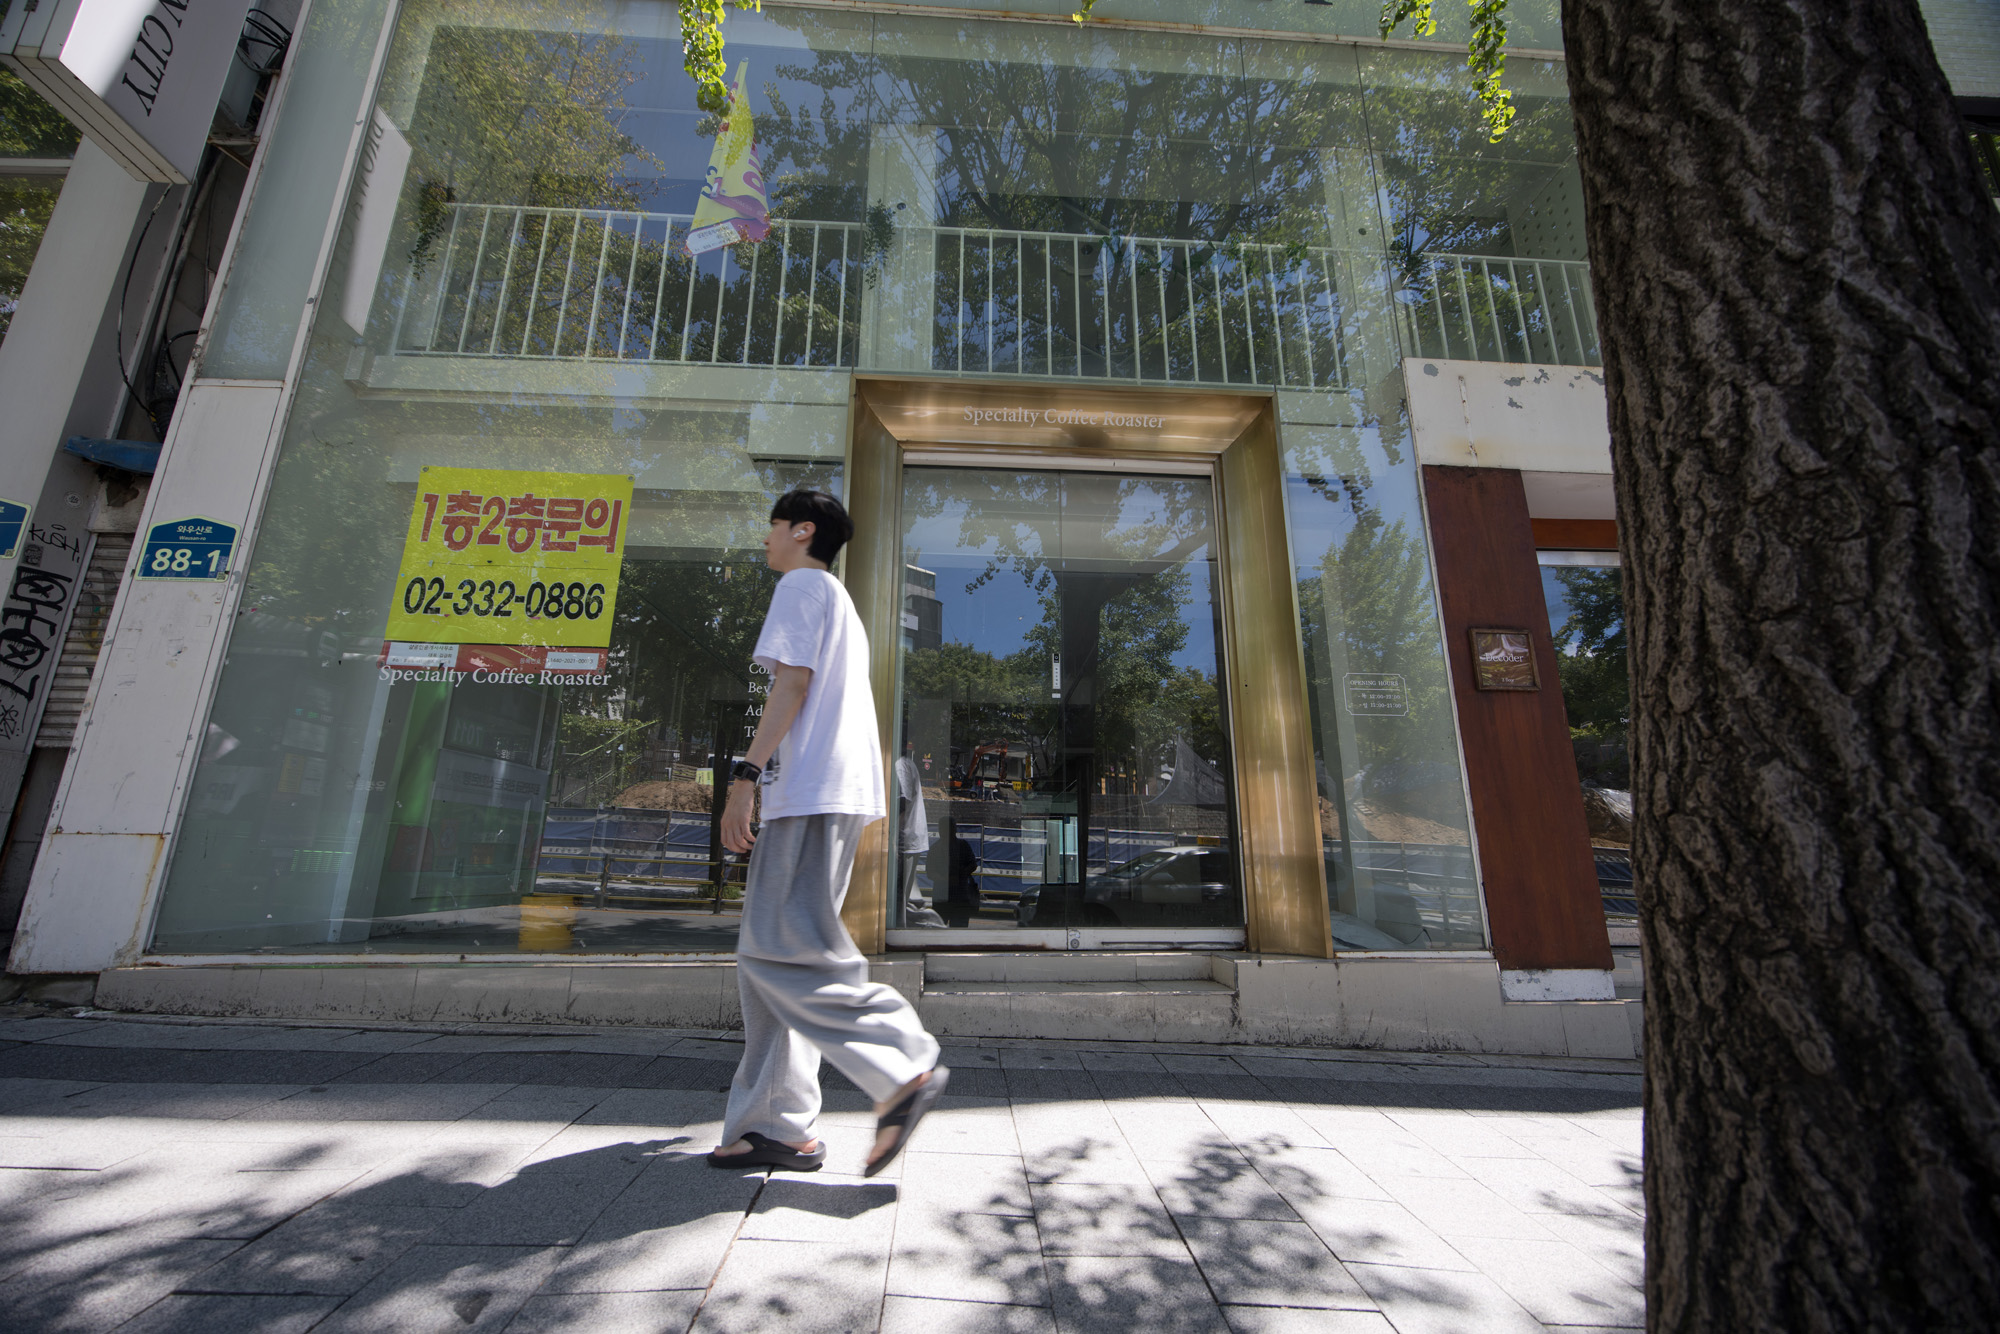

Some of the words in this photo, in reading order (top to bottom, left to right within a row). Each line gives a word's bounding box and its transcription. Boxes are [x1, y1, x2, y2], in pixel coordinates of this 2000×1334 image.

[963, 405, 1040, 427] Specialty
[1044, 408, 1098, 425] Coffee
[1102, 411, 1166, 429] Roaster
[176, 525, 213, 535] 와우산로
[420, 490, 623, 553] 1층2층문의
[151, 548, 221, 572] 88-1
[403, 576, 606, 621] 02-332-0886
[1485, 653, 1524, 662] Decoder
[379, 665, 468, 688] Specialty
[472, 667, 535, 684] Coffee
[538, 670, 612, 686] Roaster
